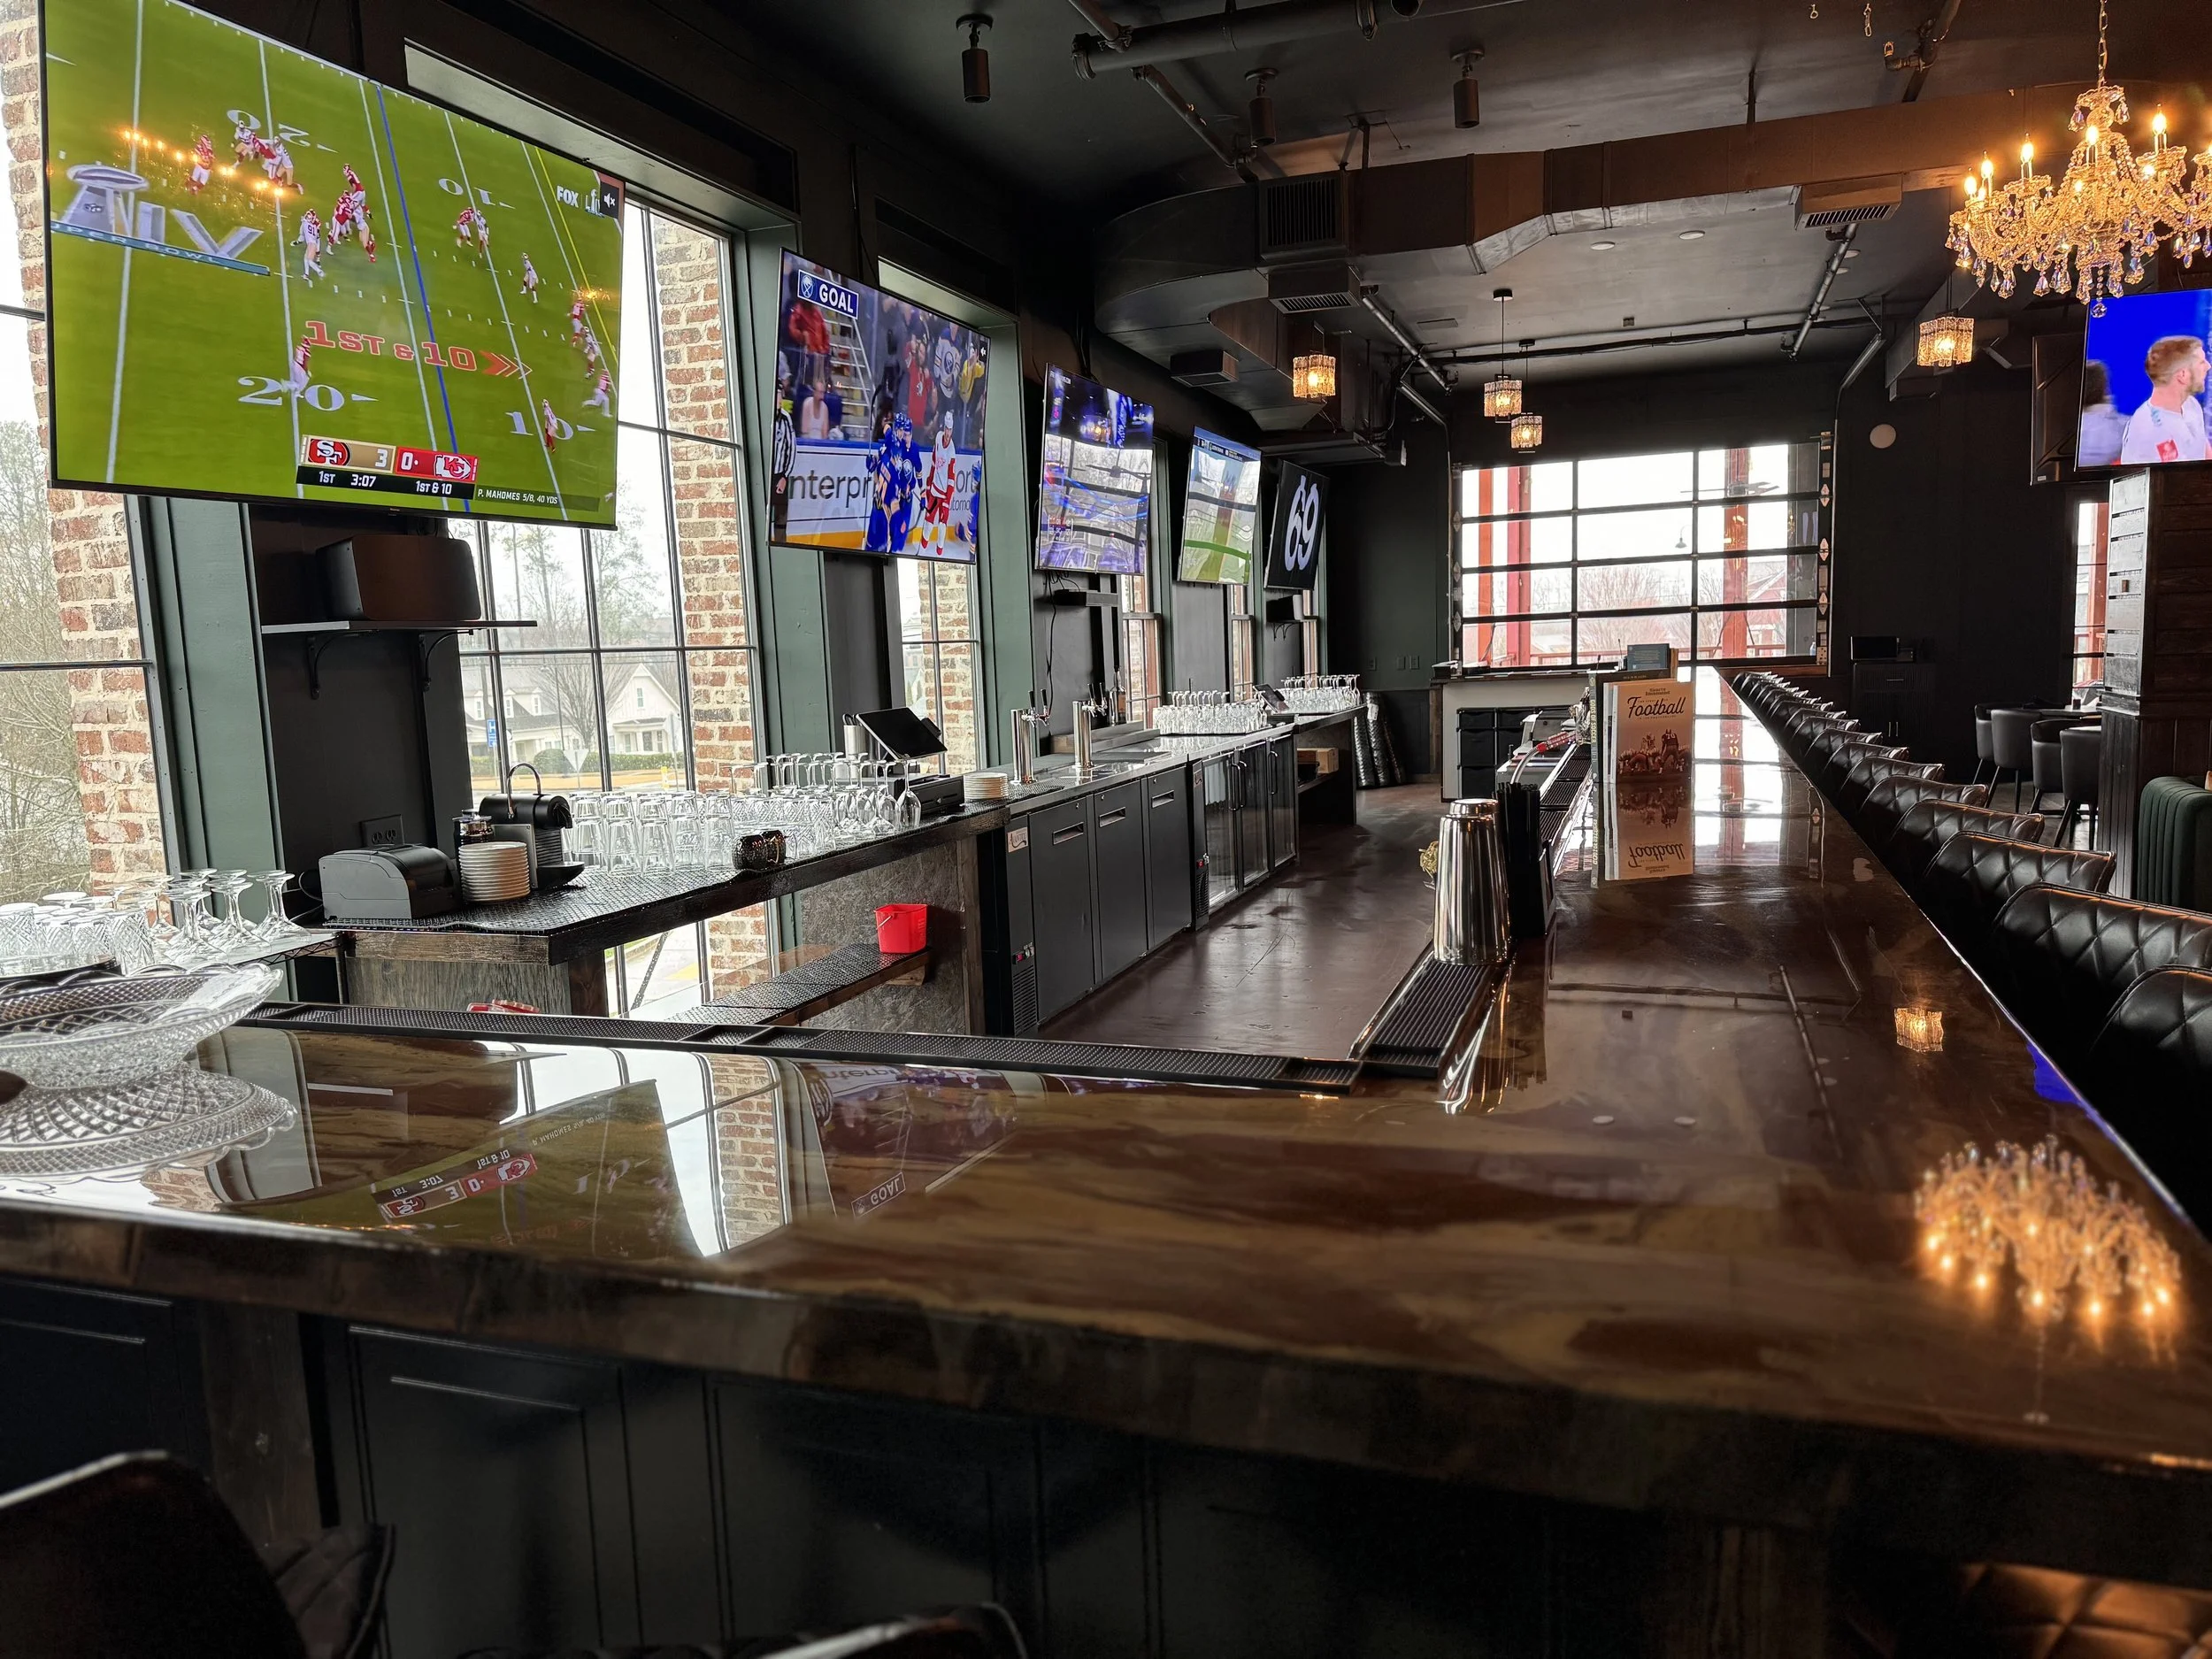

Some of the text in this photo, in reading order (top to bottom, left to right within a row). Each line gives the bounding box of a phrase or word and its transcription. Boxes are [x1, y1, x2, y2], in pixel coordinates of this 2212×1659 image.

[557, 185, 580, 208] FOX
[144, 242, 220, 264] BOWL
[818, 283, 854, 313] GOAL
[305, 320, 478, 372] 1ST & 10
[237, 376, 345, 411] 20
[374, 448, 388, 469] 3
[400, 451, 414, 471] 0
[318, 470, 377, 488] 1ST 3:07
[415, 480, 452, 495] 1ST & 10
[477, 488, 485, 497] P.
[485, 489, 520, 501] MAHOMES
[536, 495, 545, 503] 40
[546, 495, 558, 504] YDS
[1284, 474, 1319, 572] 69
[1627, 696, 1686, 718] Football
